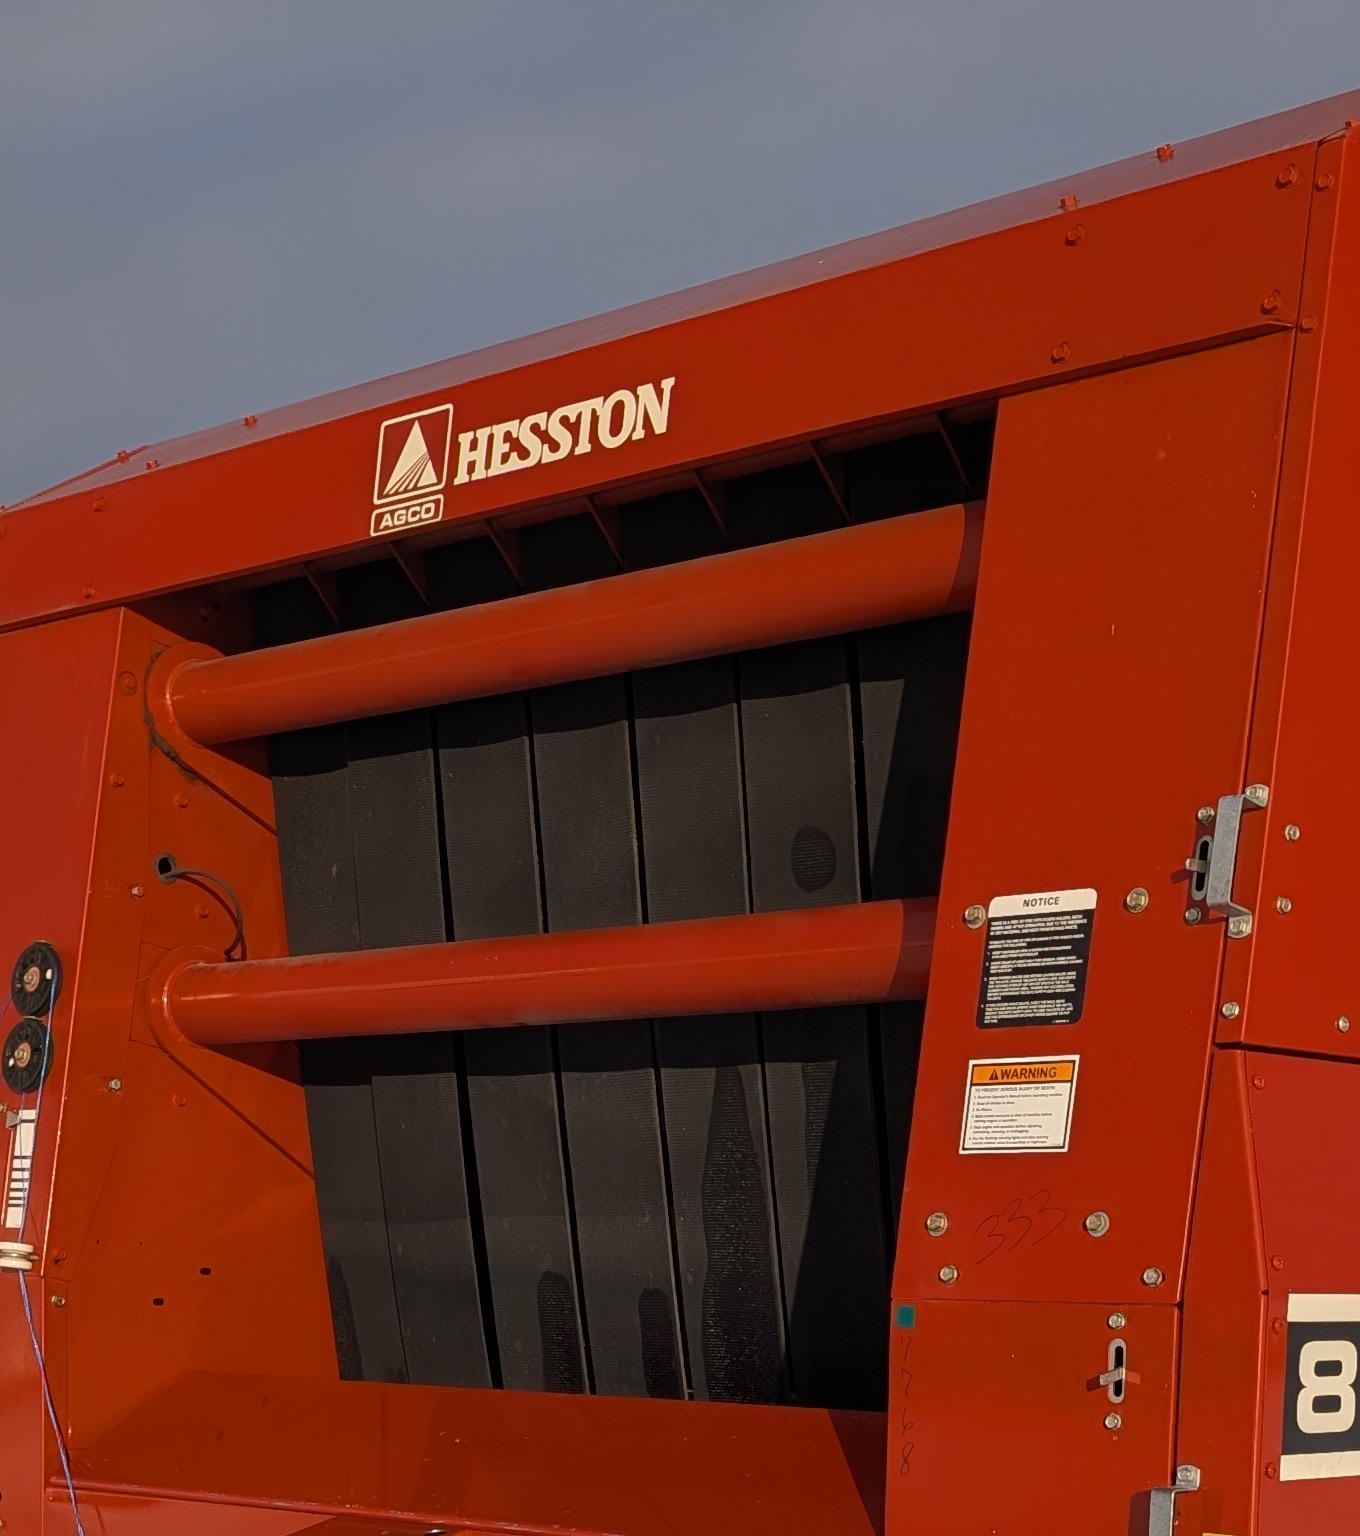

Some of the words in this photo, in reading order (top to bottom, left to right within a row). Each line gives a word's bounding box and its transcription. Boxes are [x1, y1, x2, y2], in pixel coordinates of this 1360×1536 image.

[453, 376, 676, 486] HESSTON
[378, 502, 436, 530] AGCO
[1022, 896, 1061, 908] NOTICE
[1000, 1067, 1057, 1080] WARNING
[974, 1189, 1067, 1266] 333
